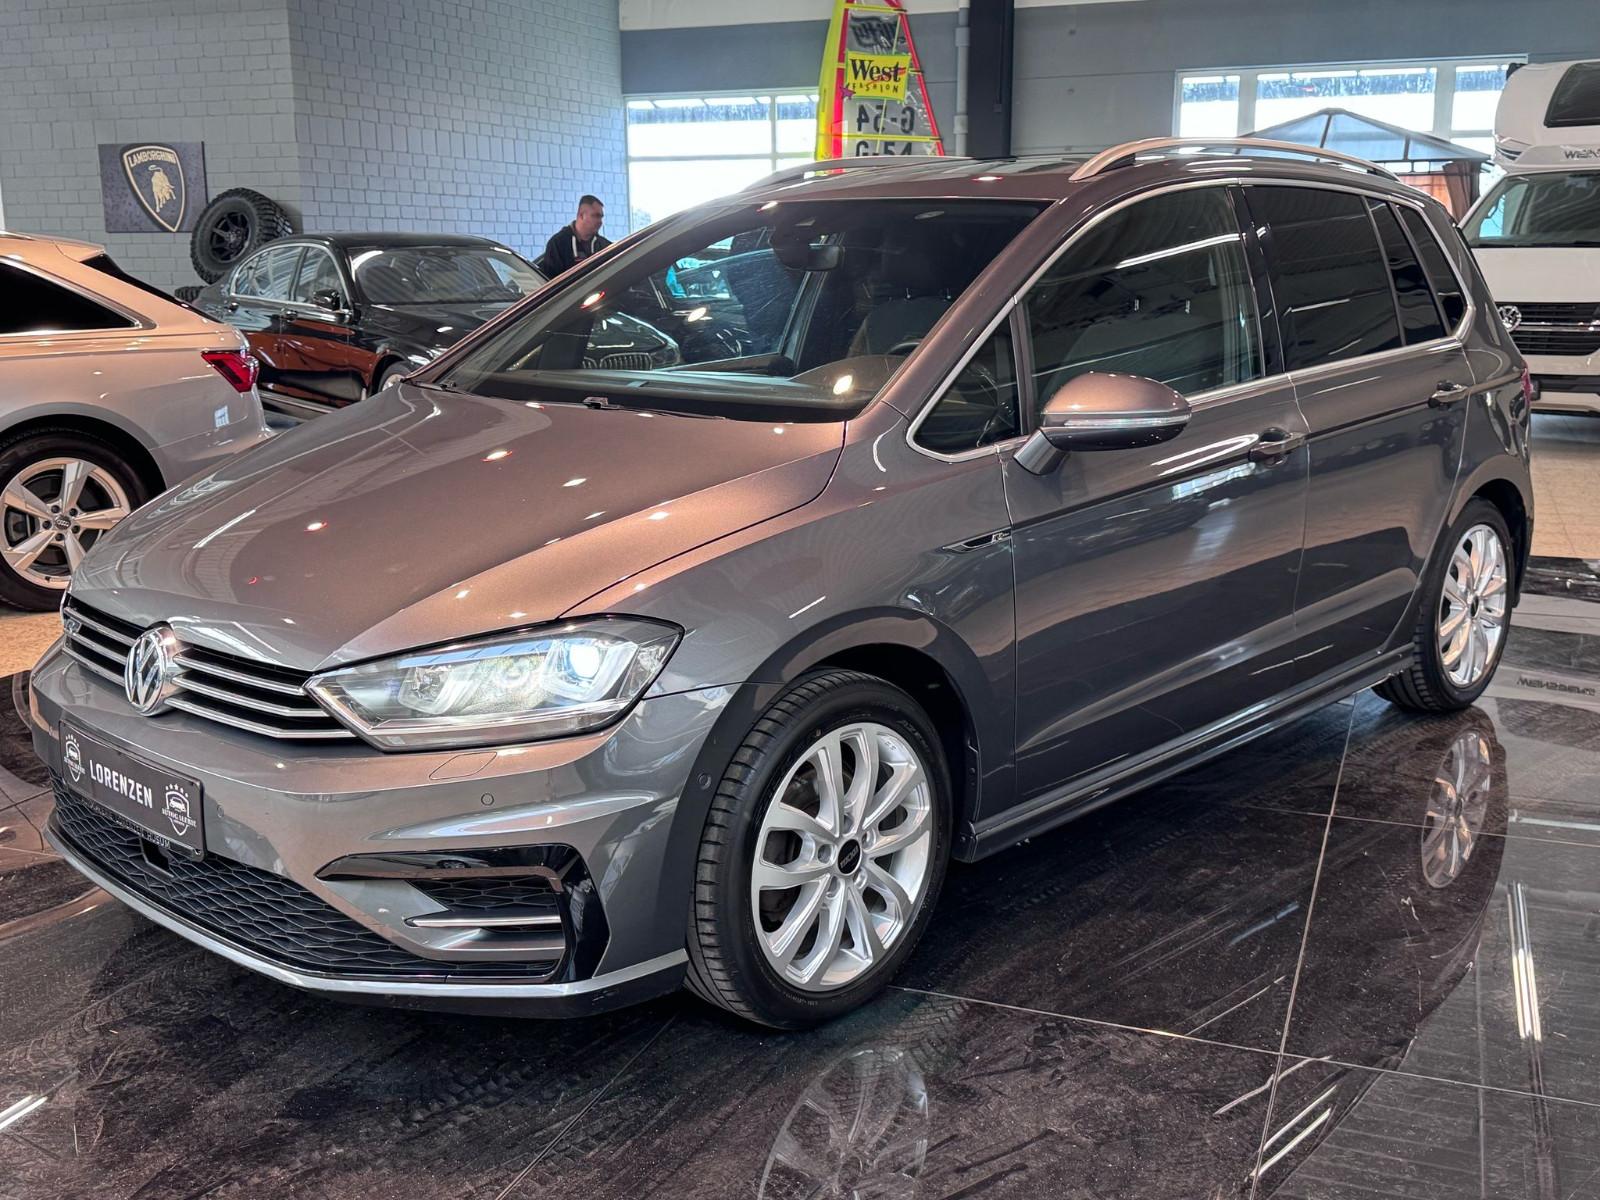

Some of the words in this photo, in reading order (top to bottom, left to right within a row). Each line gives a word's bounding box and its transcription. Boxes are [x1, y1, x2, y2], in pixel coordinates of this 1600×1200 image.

[849, 58, 906, 82] West
[128, 151, 177, 168] LAMBORGHINI
[89, 759, 153, 809] LORENZEN
